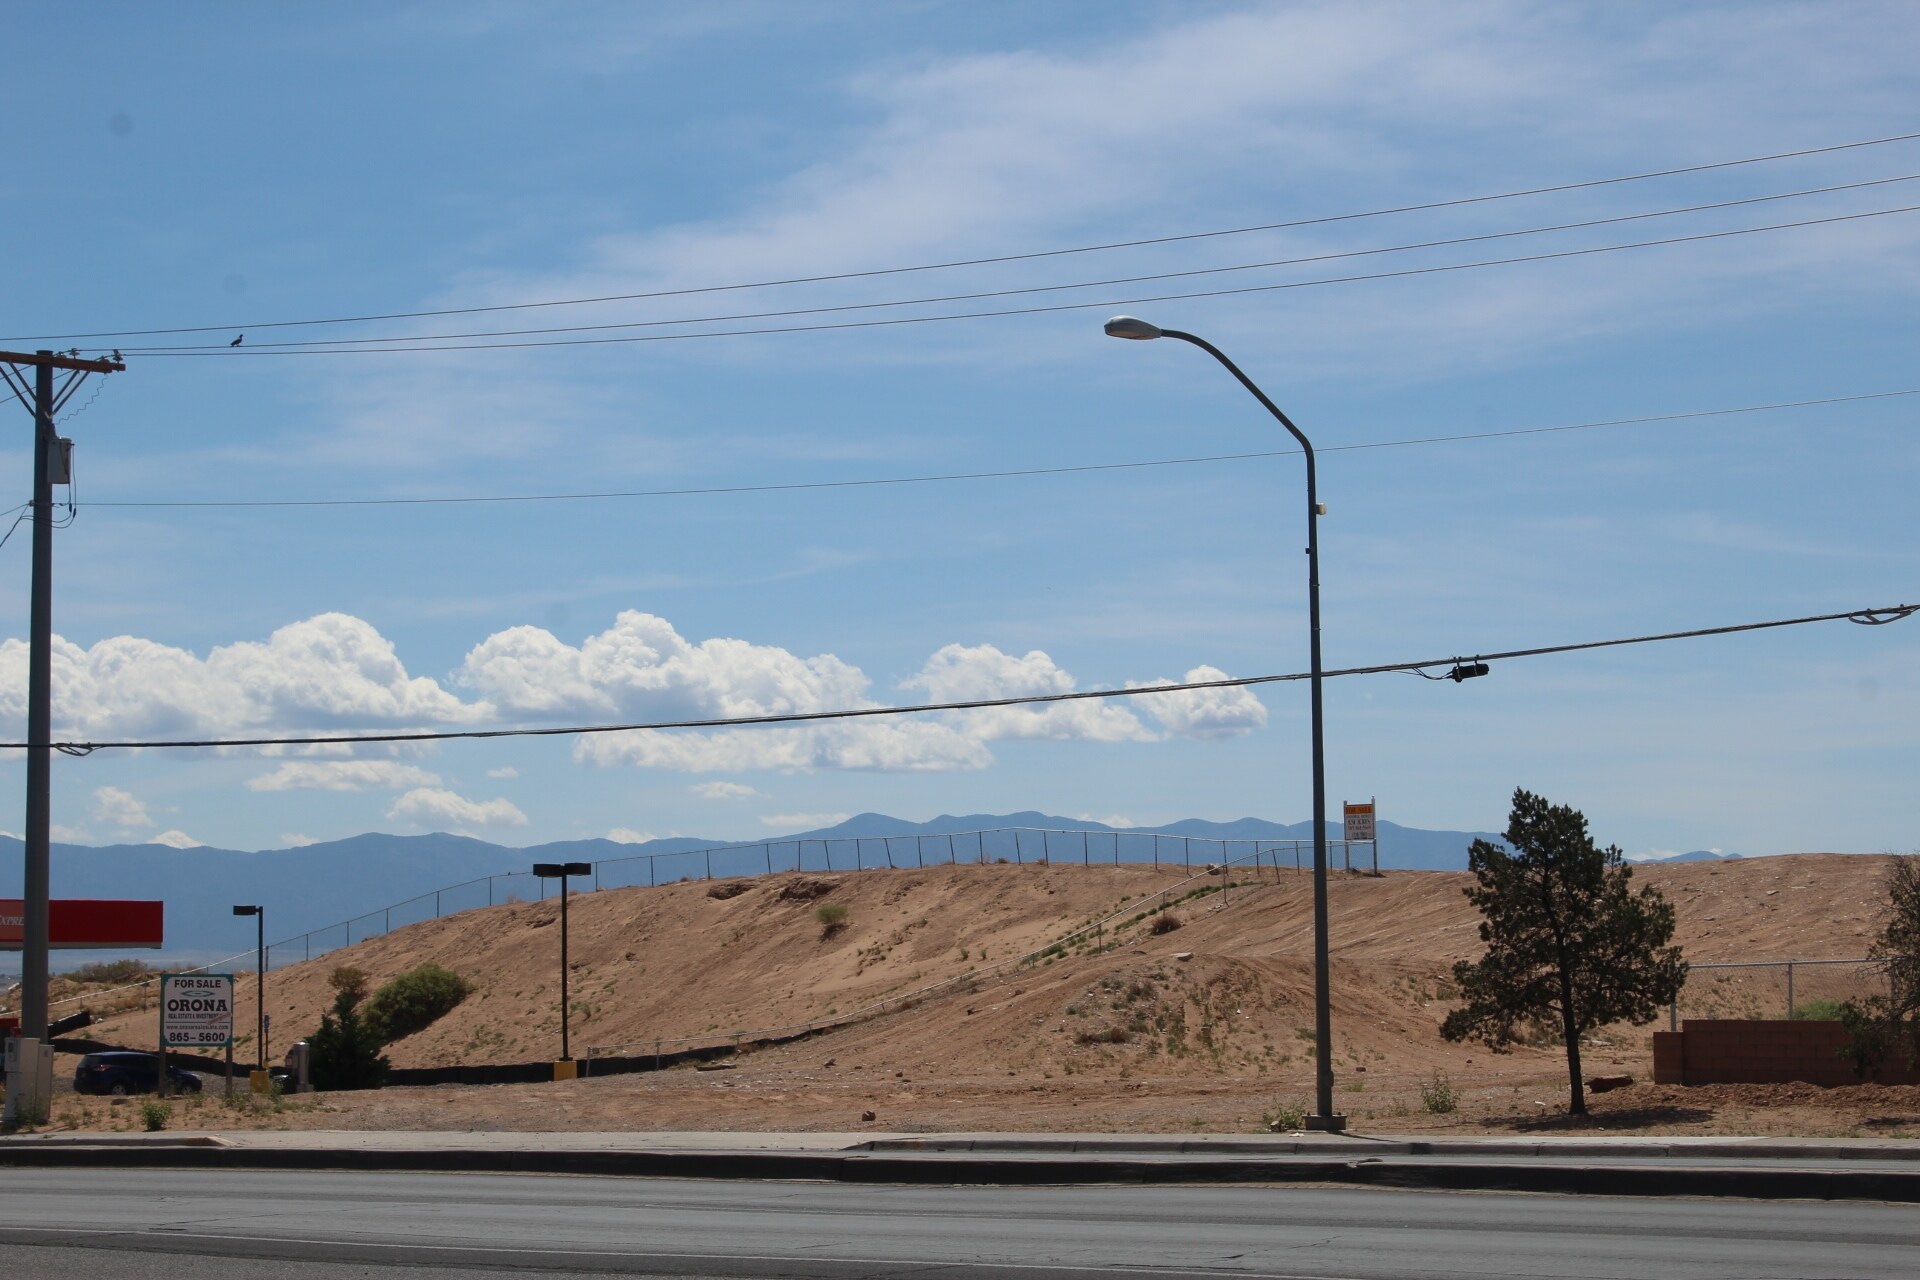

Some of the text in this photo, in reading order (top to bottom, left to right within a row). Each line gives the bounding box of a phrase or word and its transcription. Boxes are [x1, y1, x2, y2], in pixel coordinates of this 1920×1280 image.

[174, 979, 221, 988] FOR SALE
[167, 999, 228, 1012] ORONA
[198, 1032, 225, 1042] 5600
